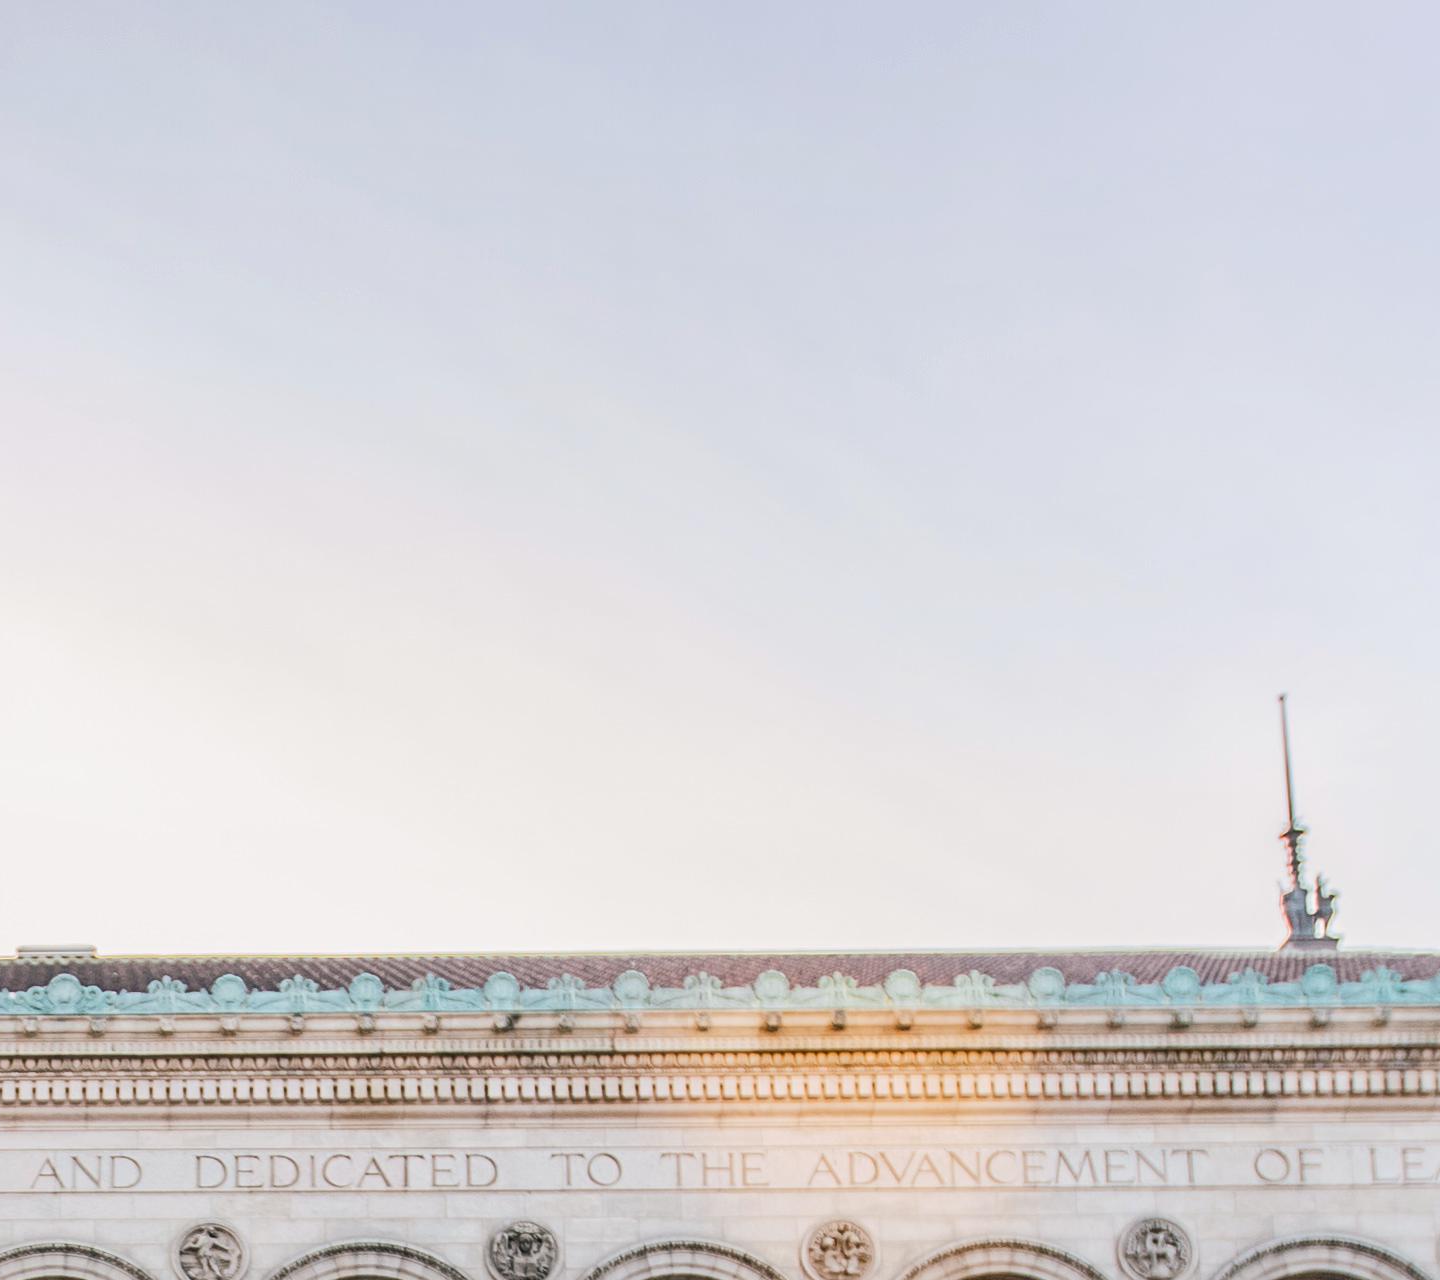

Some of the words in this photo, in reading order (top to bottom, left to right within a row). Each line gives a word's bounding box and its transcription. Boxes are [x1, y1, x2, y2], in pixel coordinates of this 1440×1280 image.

[30, 1154, 144, 1190] AND
[195, 1153, 499, 1189] DEDICATED
[551, 1152, 622, 1187] TO
[660, 1151, 770, 1188] THE
[807, 1149, 1208, 1187] ADVANCEMENT
[1253, 1148, 1324, 1184] OF
